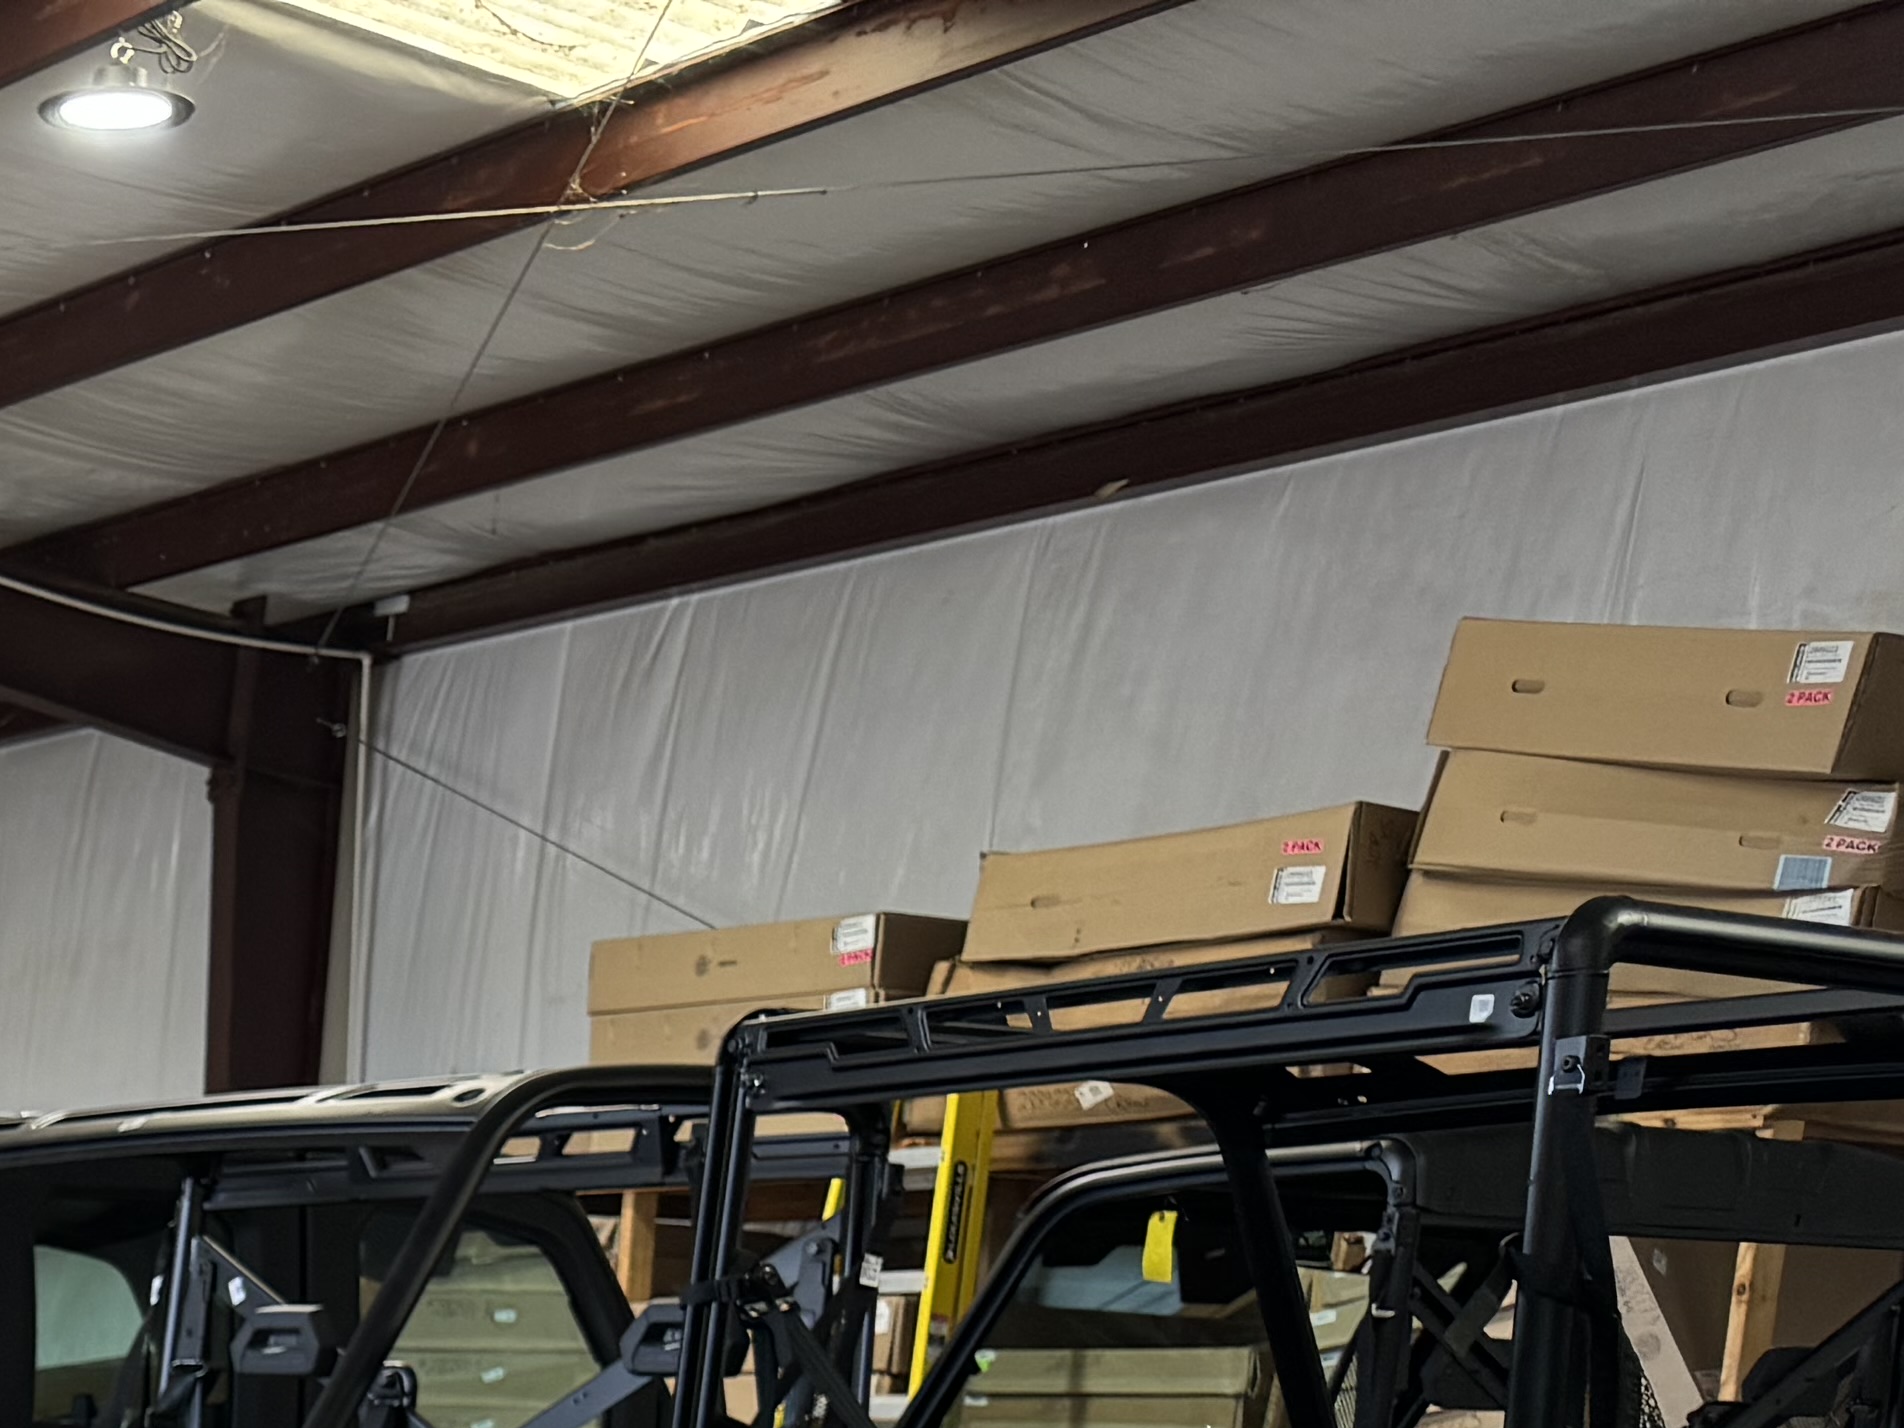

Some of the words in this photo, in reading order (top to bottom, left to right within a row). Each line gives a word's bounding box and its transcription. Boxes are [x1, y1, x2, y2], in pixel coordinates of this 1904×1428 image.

[1797, 690, 1832, 704] PACK
[1824, 836, 1834, 848] 2
[1835, 838, 1877, 853] PACK
